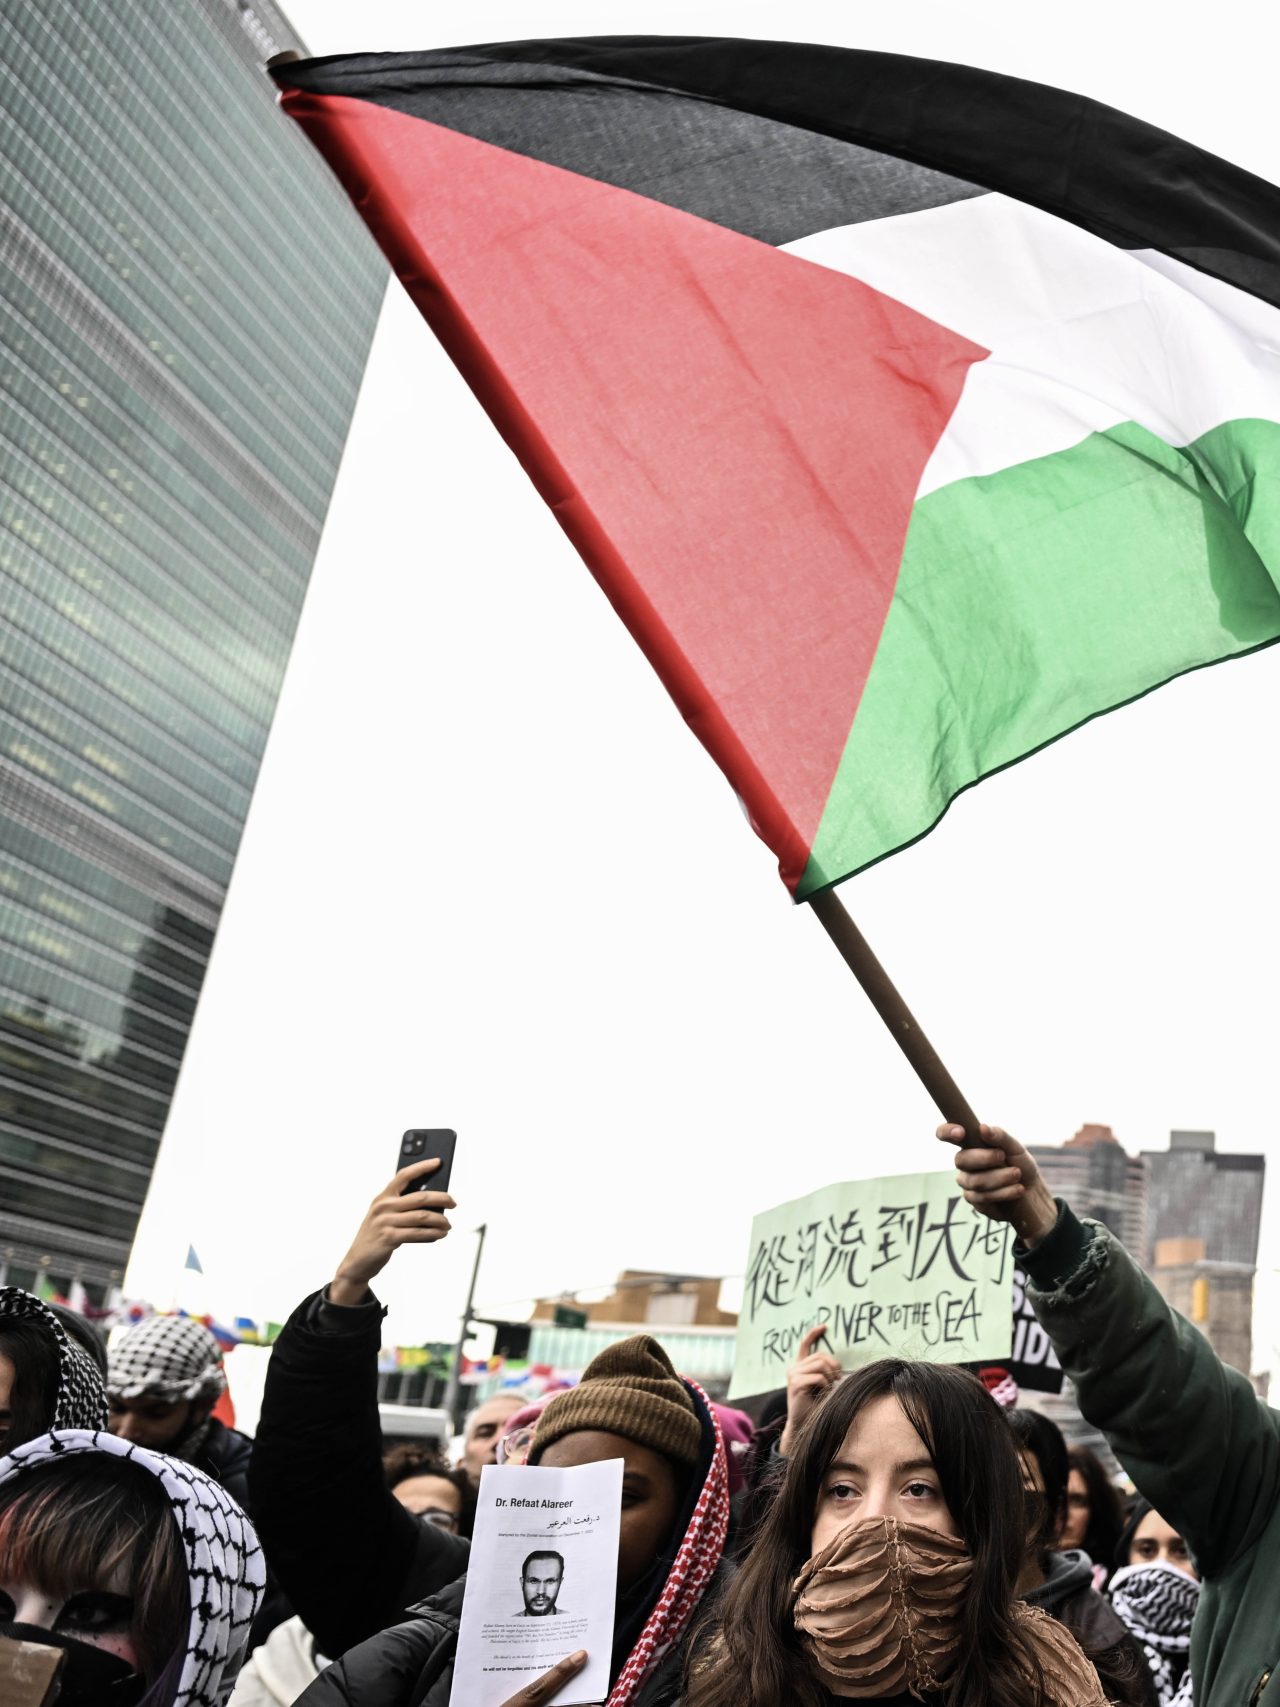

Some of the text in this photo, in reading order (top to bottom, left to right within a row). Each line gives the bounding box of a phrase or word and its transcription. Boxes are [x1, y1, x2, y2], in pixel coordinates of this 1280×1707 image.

[813, 1300, 890, 1355] RIVER
[922, 1287, 982, 1346] SEA
[496, 1497, 574, 1509] Dr. Refaat Alareer
